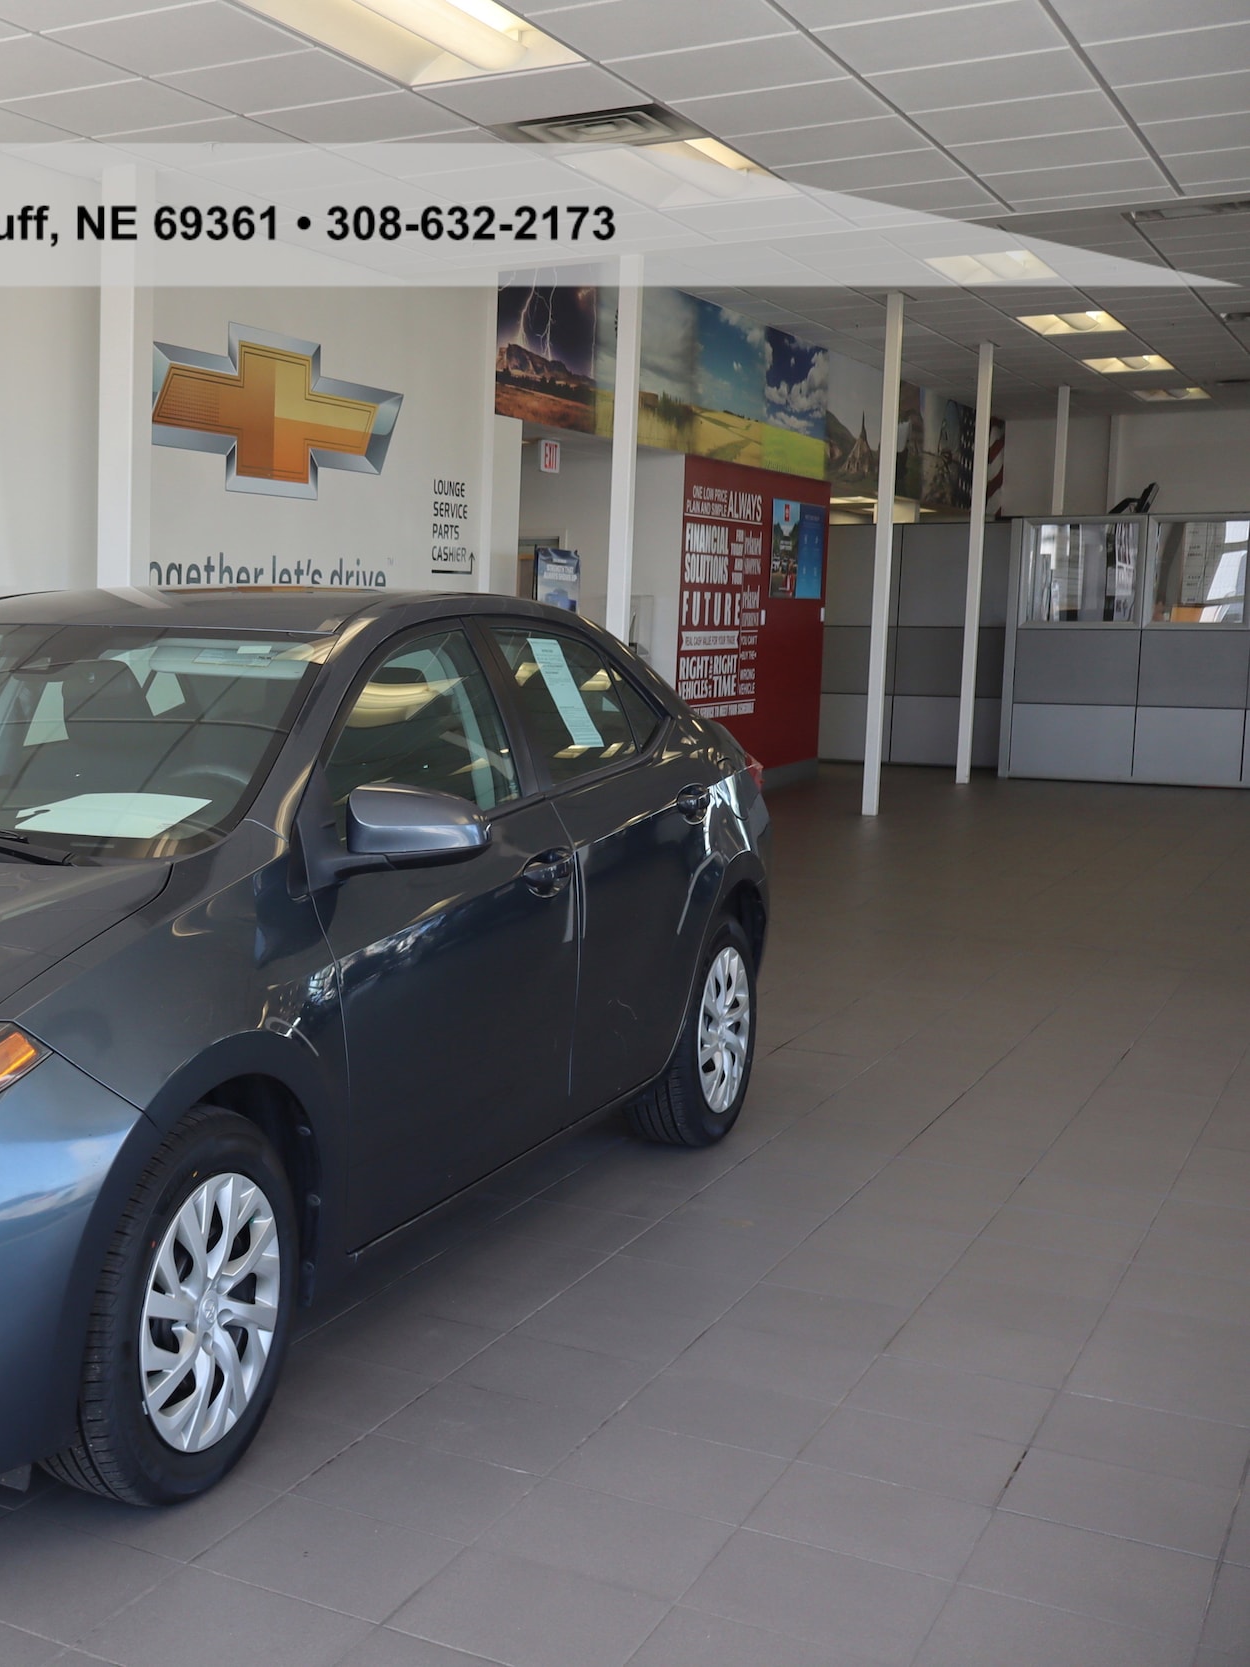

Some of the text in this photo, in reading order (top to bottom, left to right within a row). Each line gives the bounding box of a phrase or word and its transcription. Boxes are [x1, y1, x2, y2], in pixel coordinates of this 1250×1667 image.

[544, 443, 558, 469] EXIT
[433, 479, 465, 498] LOUNGE
[433, 501, 468, 520] SERVICE
[727, 491, 762, 522] ALWAYS
[432, 523, 460, 540] PARTS
[685, 522, 729, 555] FINANCIAL
[431, 545, 467, 562] CASHIER
[330, 557, 386, 588] drive
[684, 552, 729, 585] SOLUTIONS
[682, 591, 741, 627] FUTURE
[679, 656, 709, 680] RIGHT
[713, 654, 738, 675] RIGHT
[678, 680, 709, 700] VEHICLES
[713, 675, 737, 698] TIME
